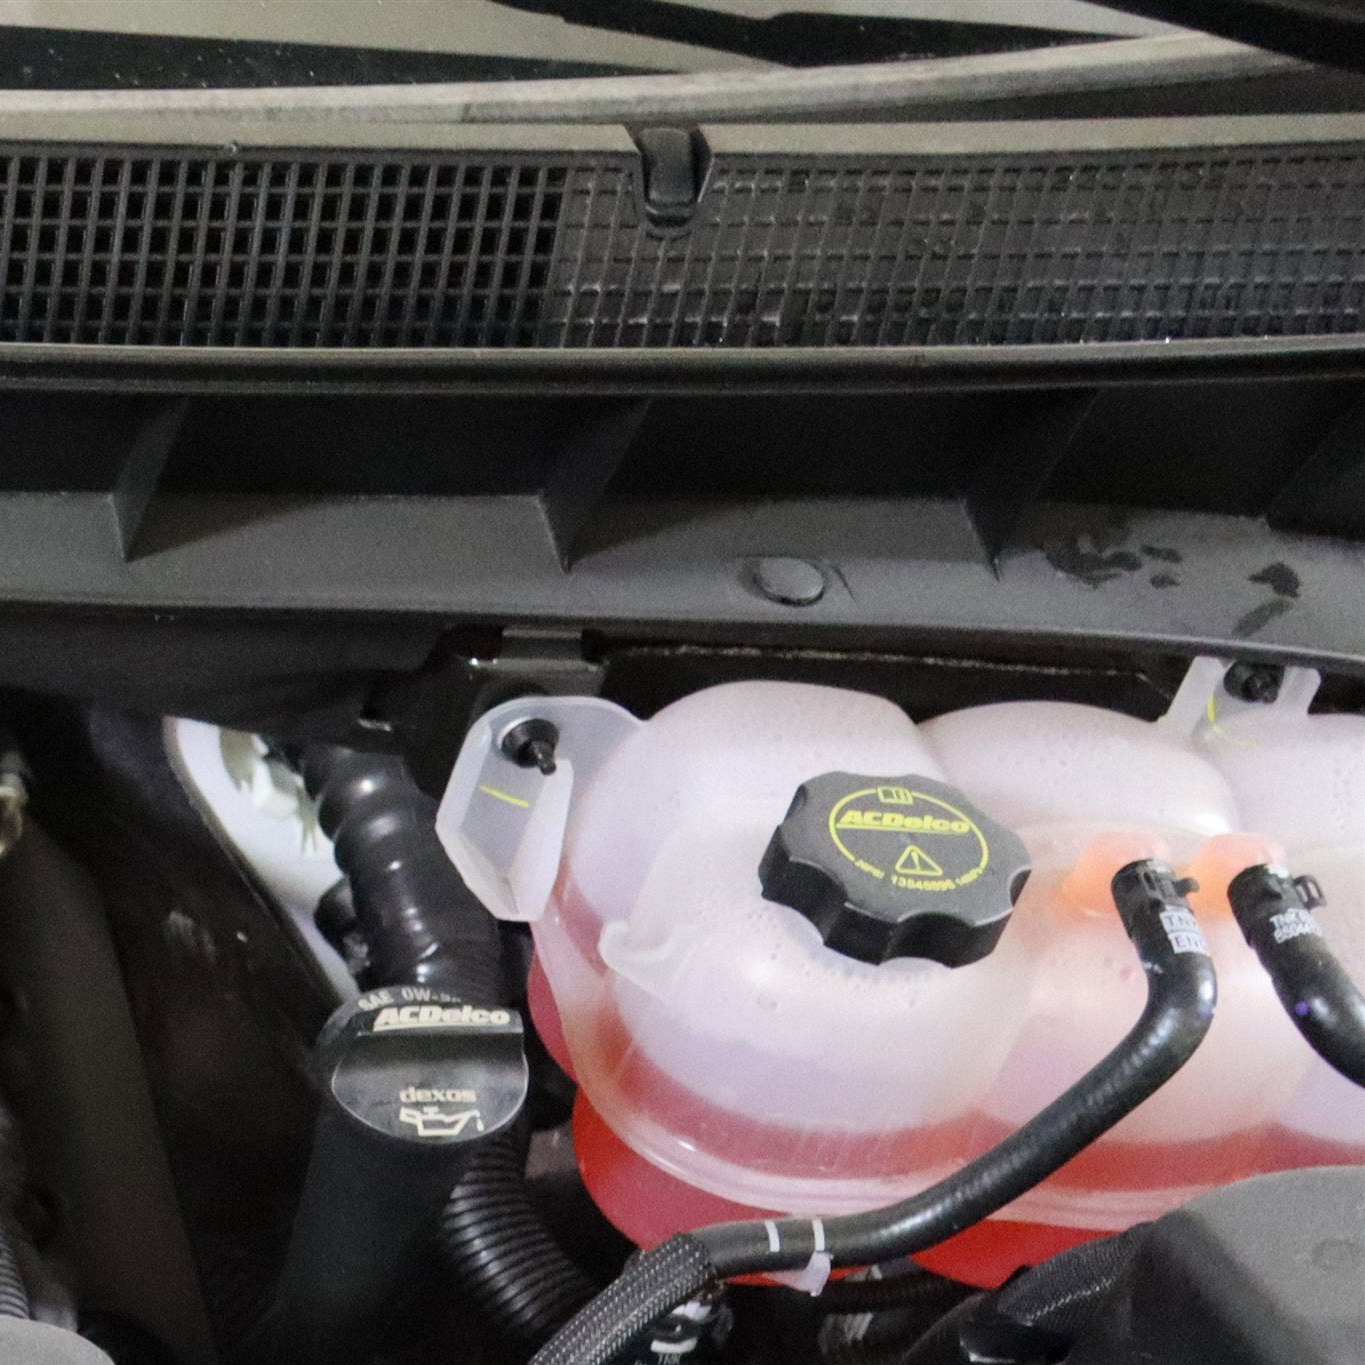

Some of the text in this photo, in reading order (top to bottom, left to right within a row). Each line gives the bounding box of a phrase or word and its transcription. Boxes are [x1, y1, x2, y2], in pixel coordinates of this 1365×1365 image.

[837, 810, 970, 834] ACDelco
[358, 989, 395, 1012] SAE
[374, 1004, 511, 1029] ACDelco
[399, 1086, 477, 1102] dexos
